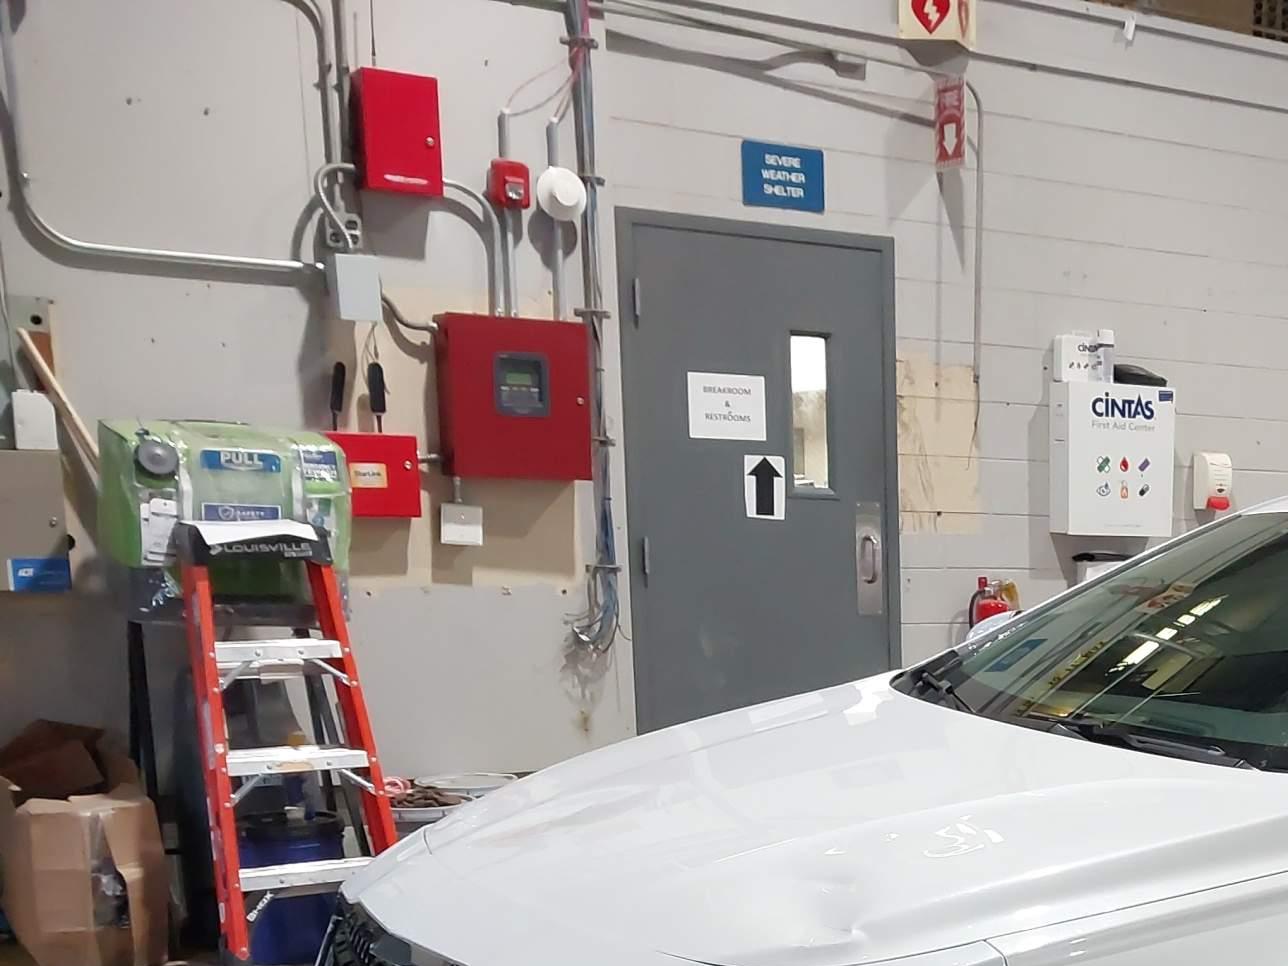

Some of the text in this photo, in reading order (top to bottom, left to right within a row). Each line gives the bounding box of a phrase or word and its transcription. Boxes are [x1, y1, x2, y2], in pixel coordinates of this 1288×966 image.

[764, 153, 801, 169] SEVERE
[761, 169, 806, 184] WEATHER
[763, 183, 805, 199] SHELTER
[703, 385, 752, 396] BREAKROOM
[704, 412, 752, 423] RESTROOMS
[1092, 421, 1156, 432] First Aid Center
[220, 451, 263, 465] PULL
[223, 542, 311, 553] LOUISVILLE
